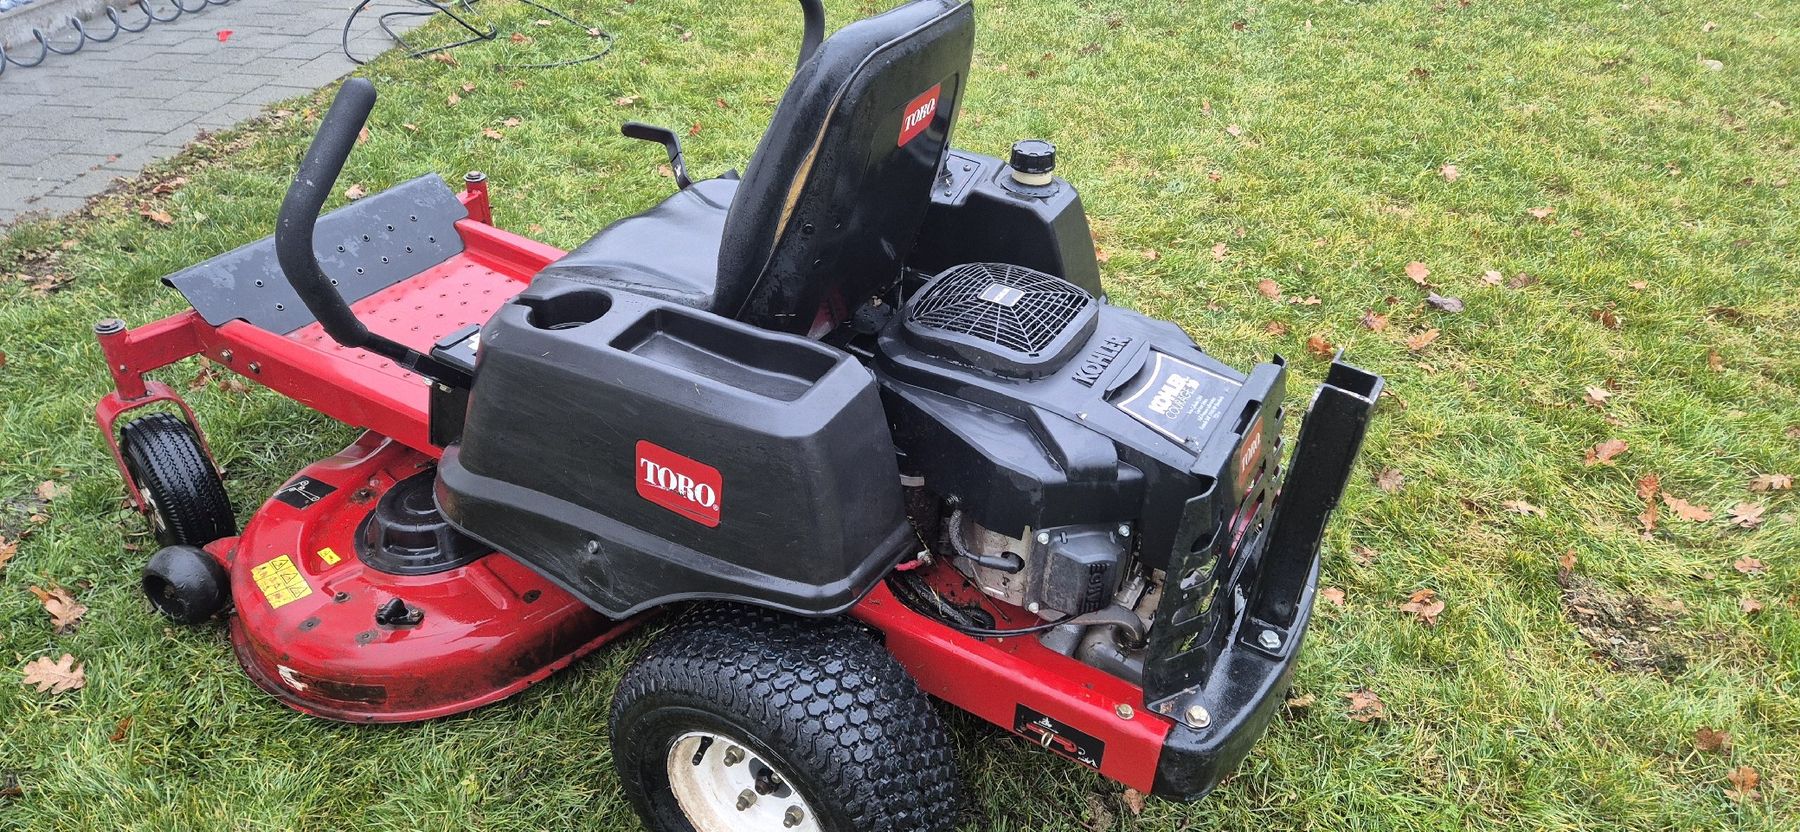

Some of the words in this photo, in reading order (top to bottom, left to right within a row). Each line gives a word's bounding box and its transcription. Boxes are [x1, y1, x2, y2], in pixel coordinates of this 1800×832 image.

[905, 98, 936, 132] TORO
[1072, 337, 1133, 388] KOHLER
[1242, 432, 1261, 472] TORO
[641, 457, 716, 508] TORO
